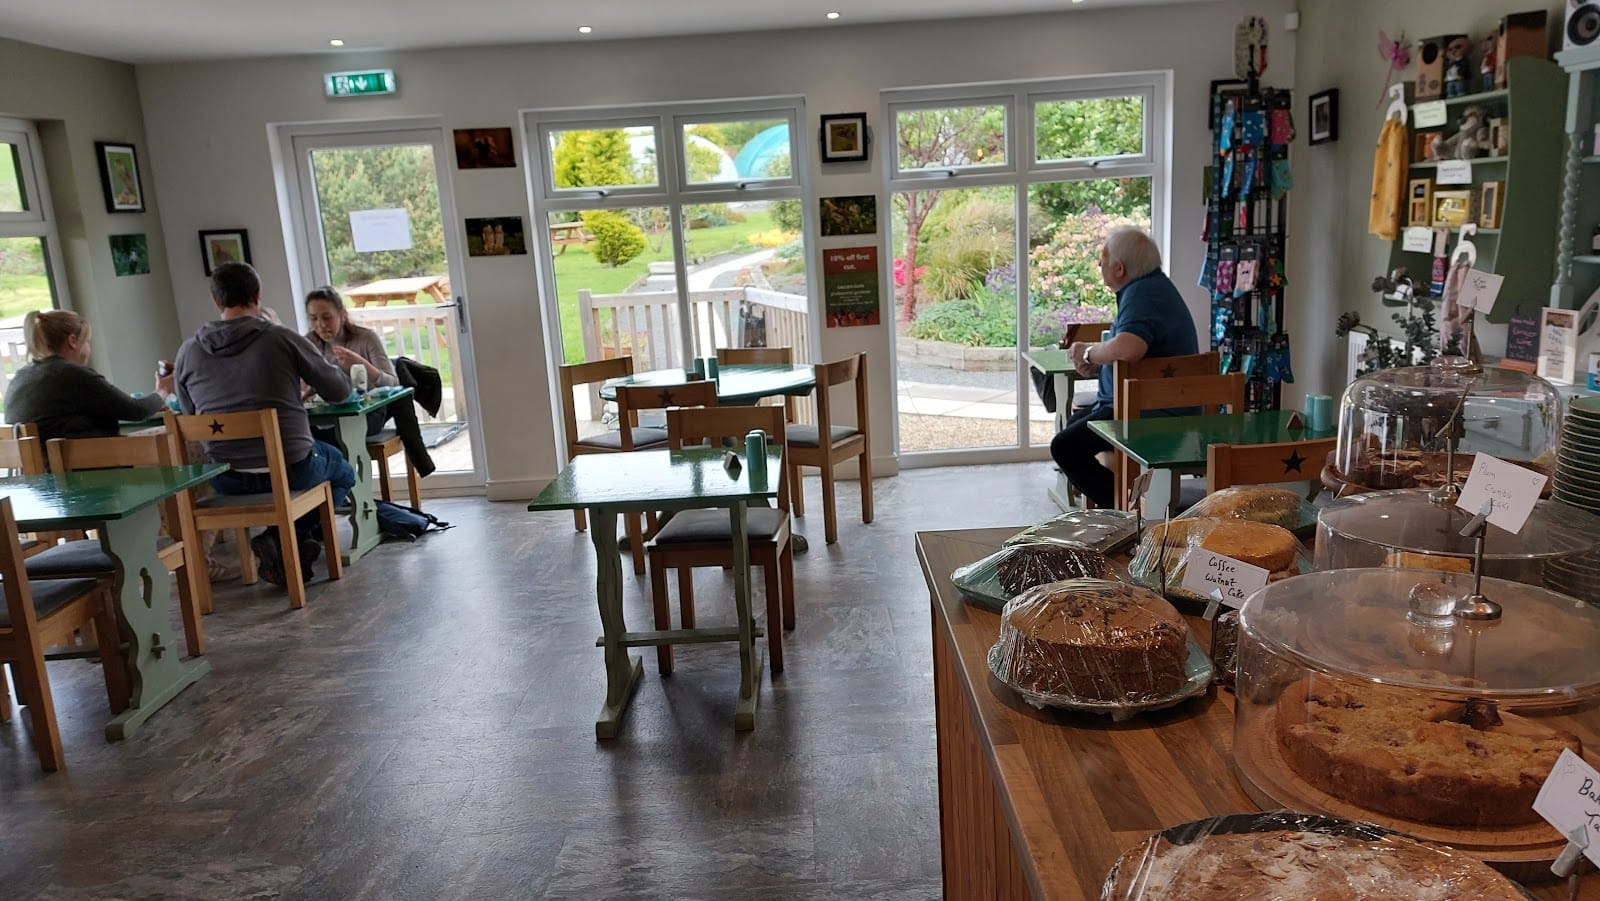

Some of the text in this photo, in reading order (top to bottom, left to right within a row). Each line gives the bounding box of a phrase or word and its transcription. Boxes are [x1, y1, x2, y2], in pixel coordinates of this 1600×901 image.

[1209, 556, 1236, 573] Coffee
[1205, 573, 1237, 587] Walnut
[1228, 588, 1245, 599] Cake
